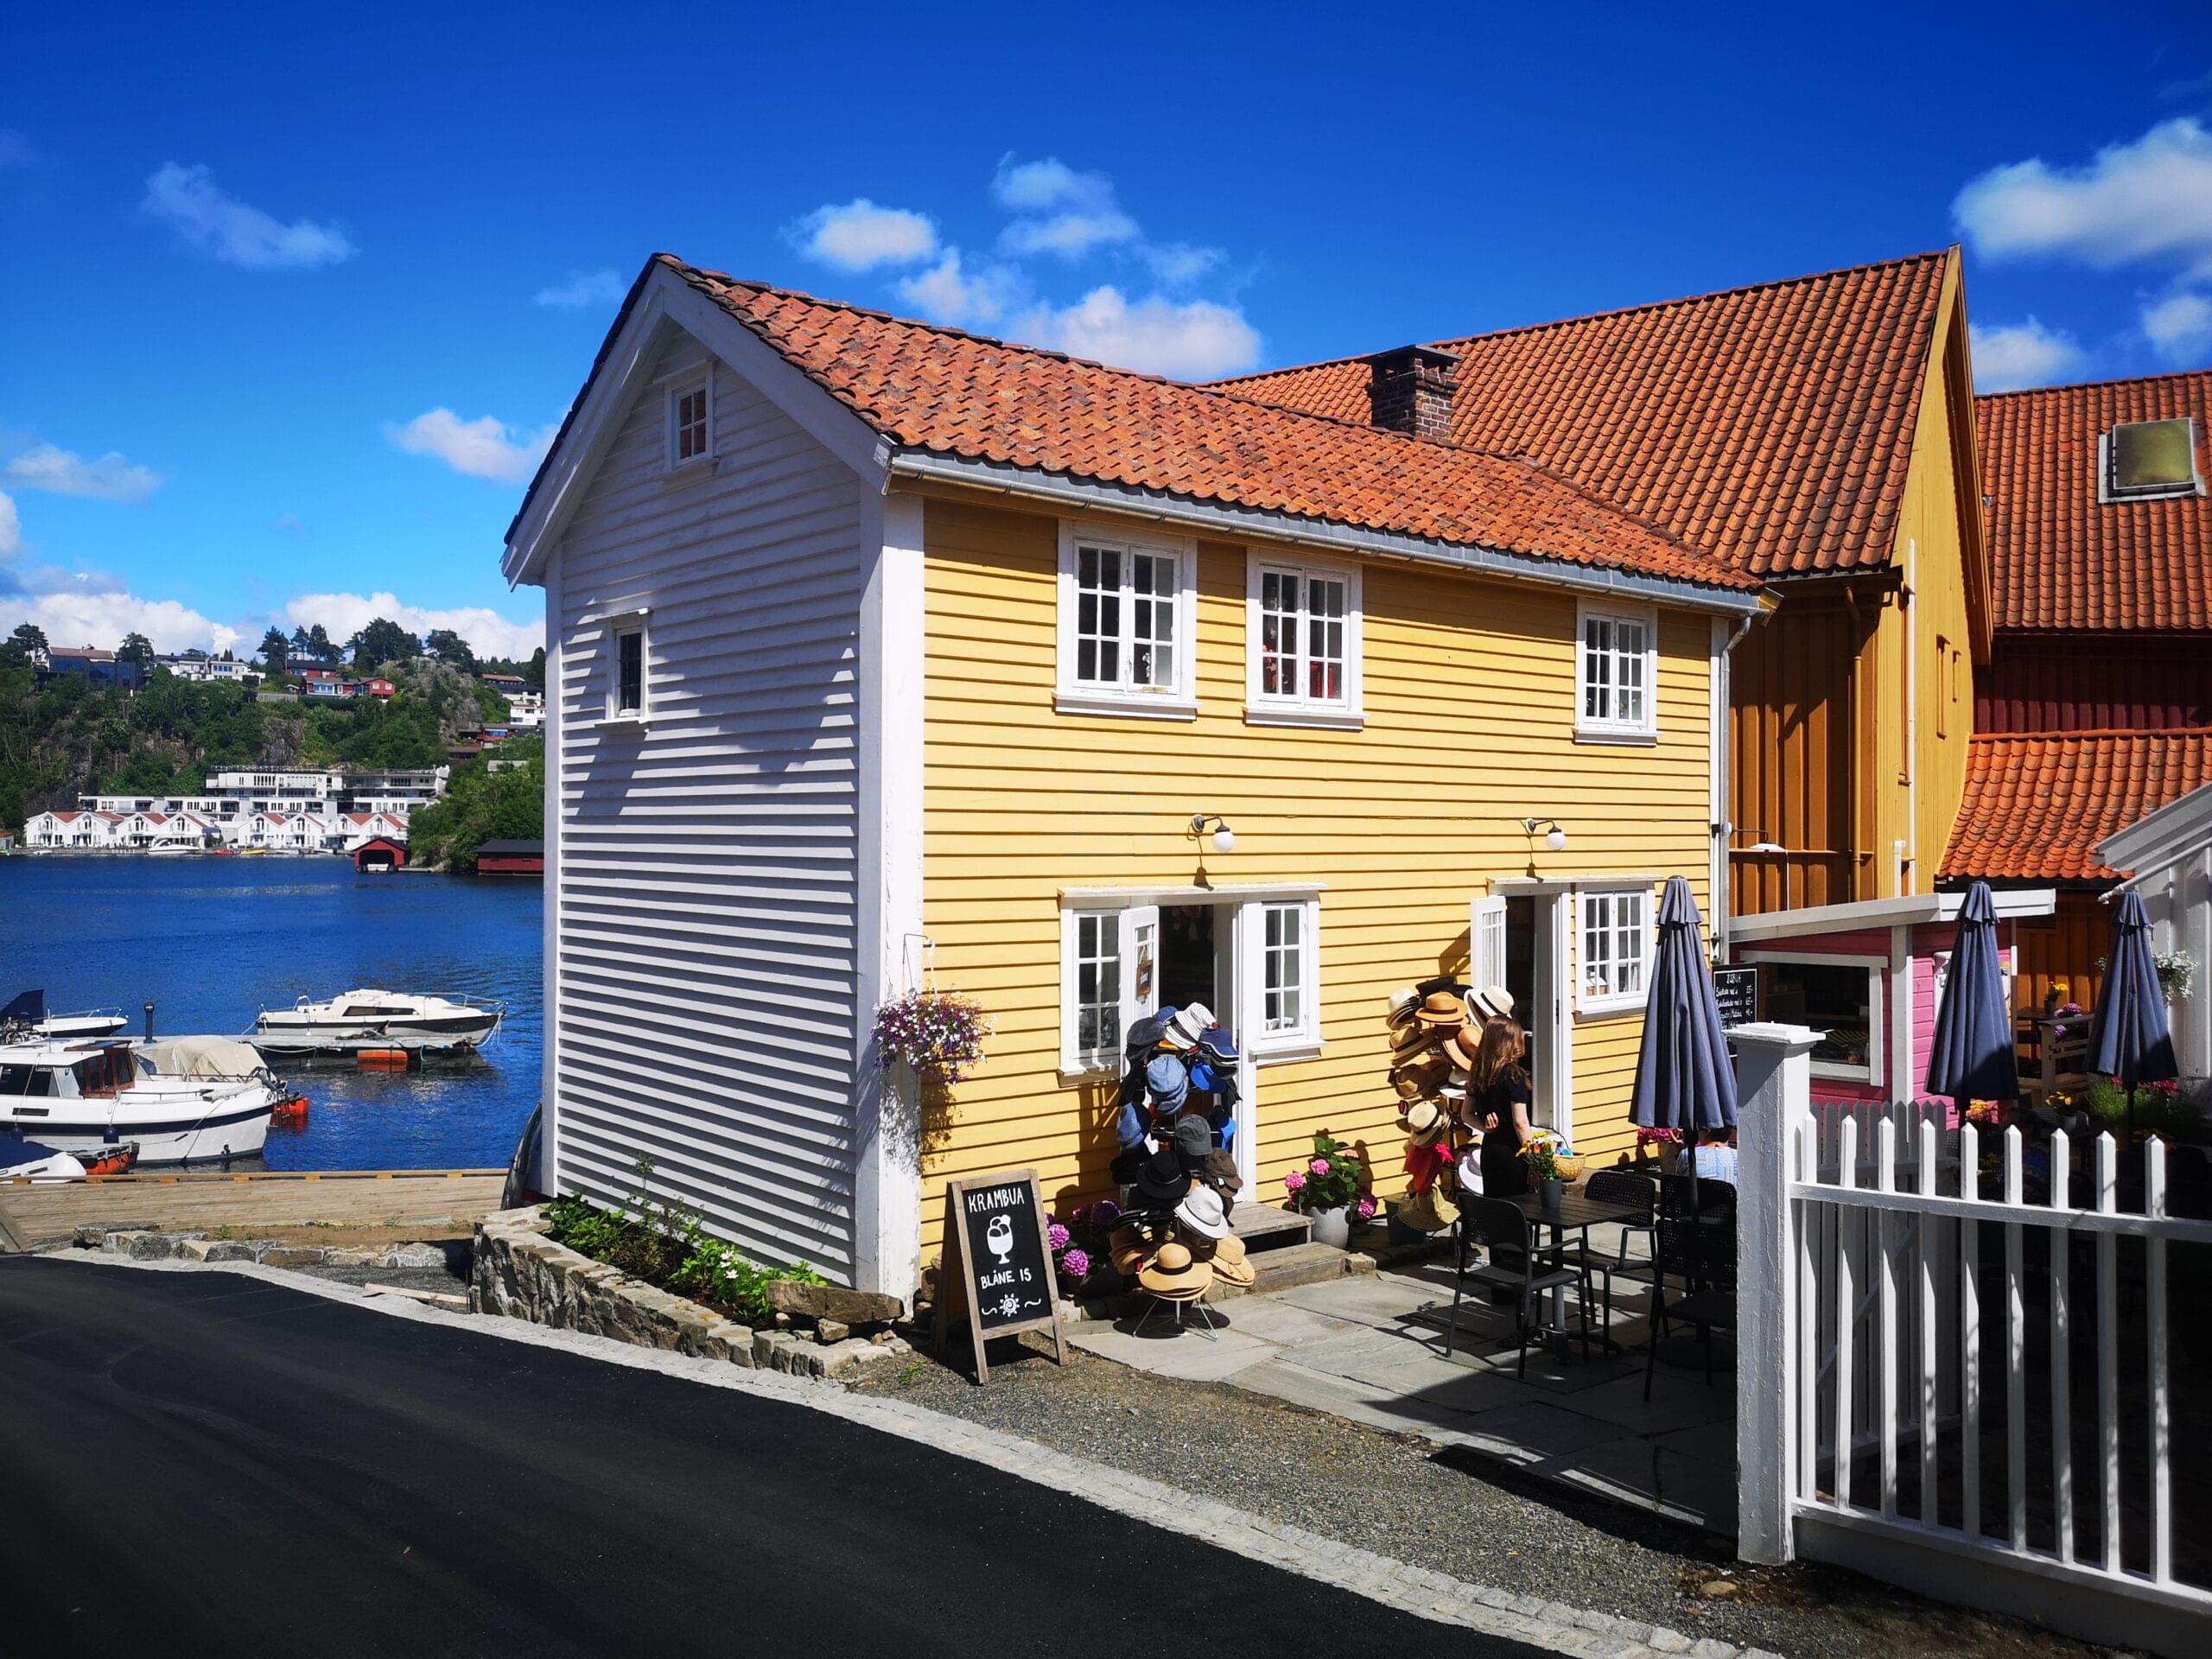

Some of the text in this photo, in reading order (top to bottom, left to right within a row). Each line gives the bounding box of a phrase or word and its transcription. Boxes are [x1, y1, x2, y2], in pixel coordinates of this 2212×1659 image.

[968, 1187, 1025, 1213] KRAMBUA
[980, 1268, 1032, 1290] BLÅNE IS
